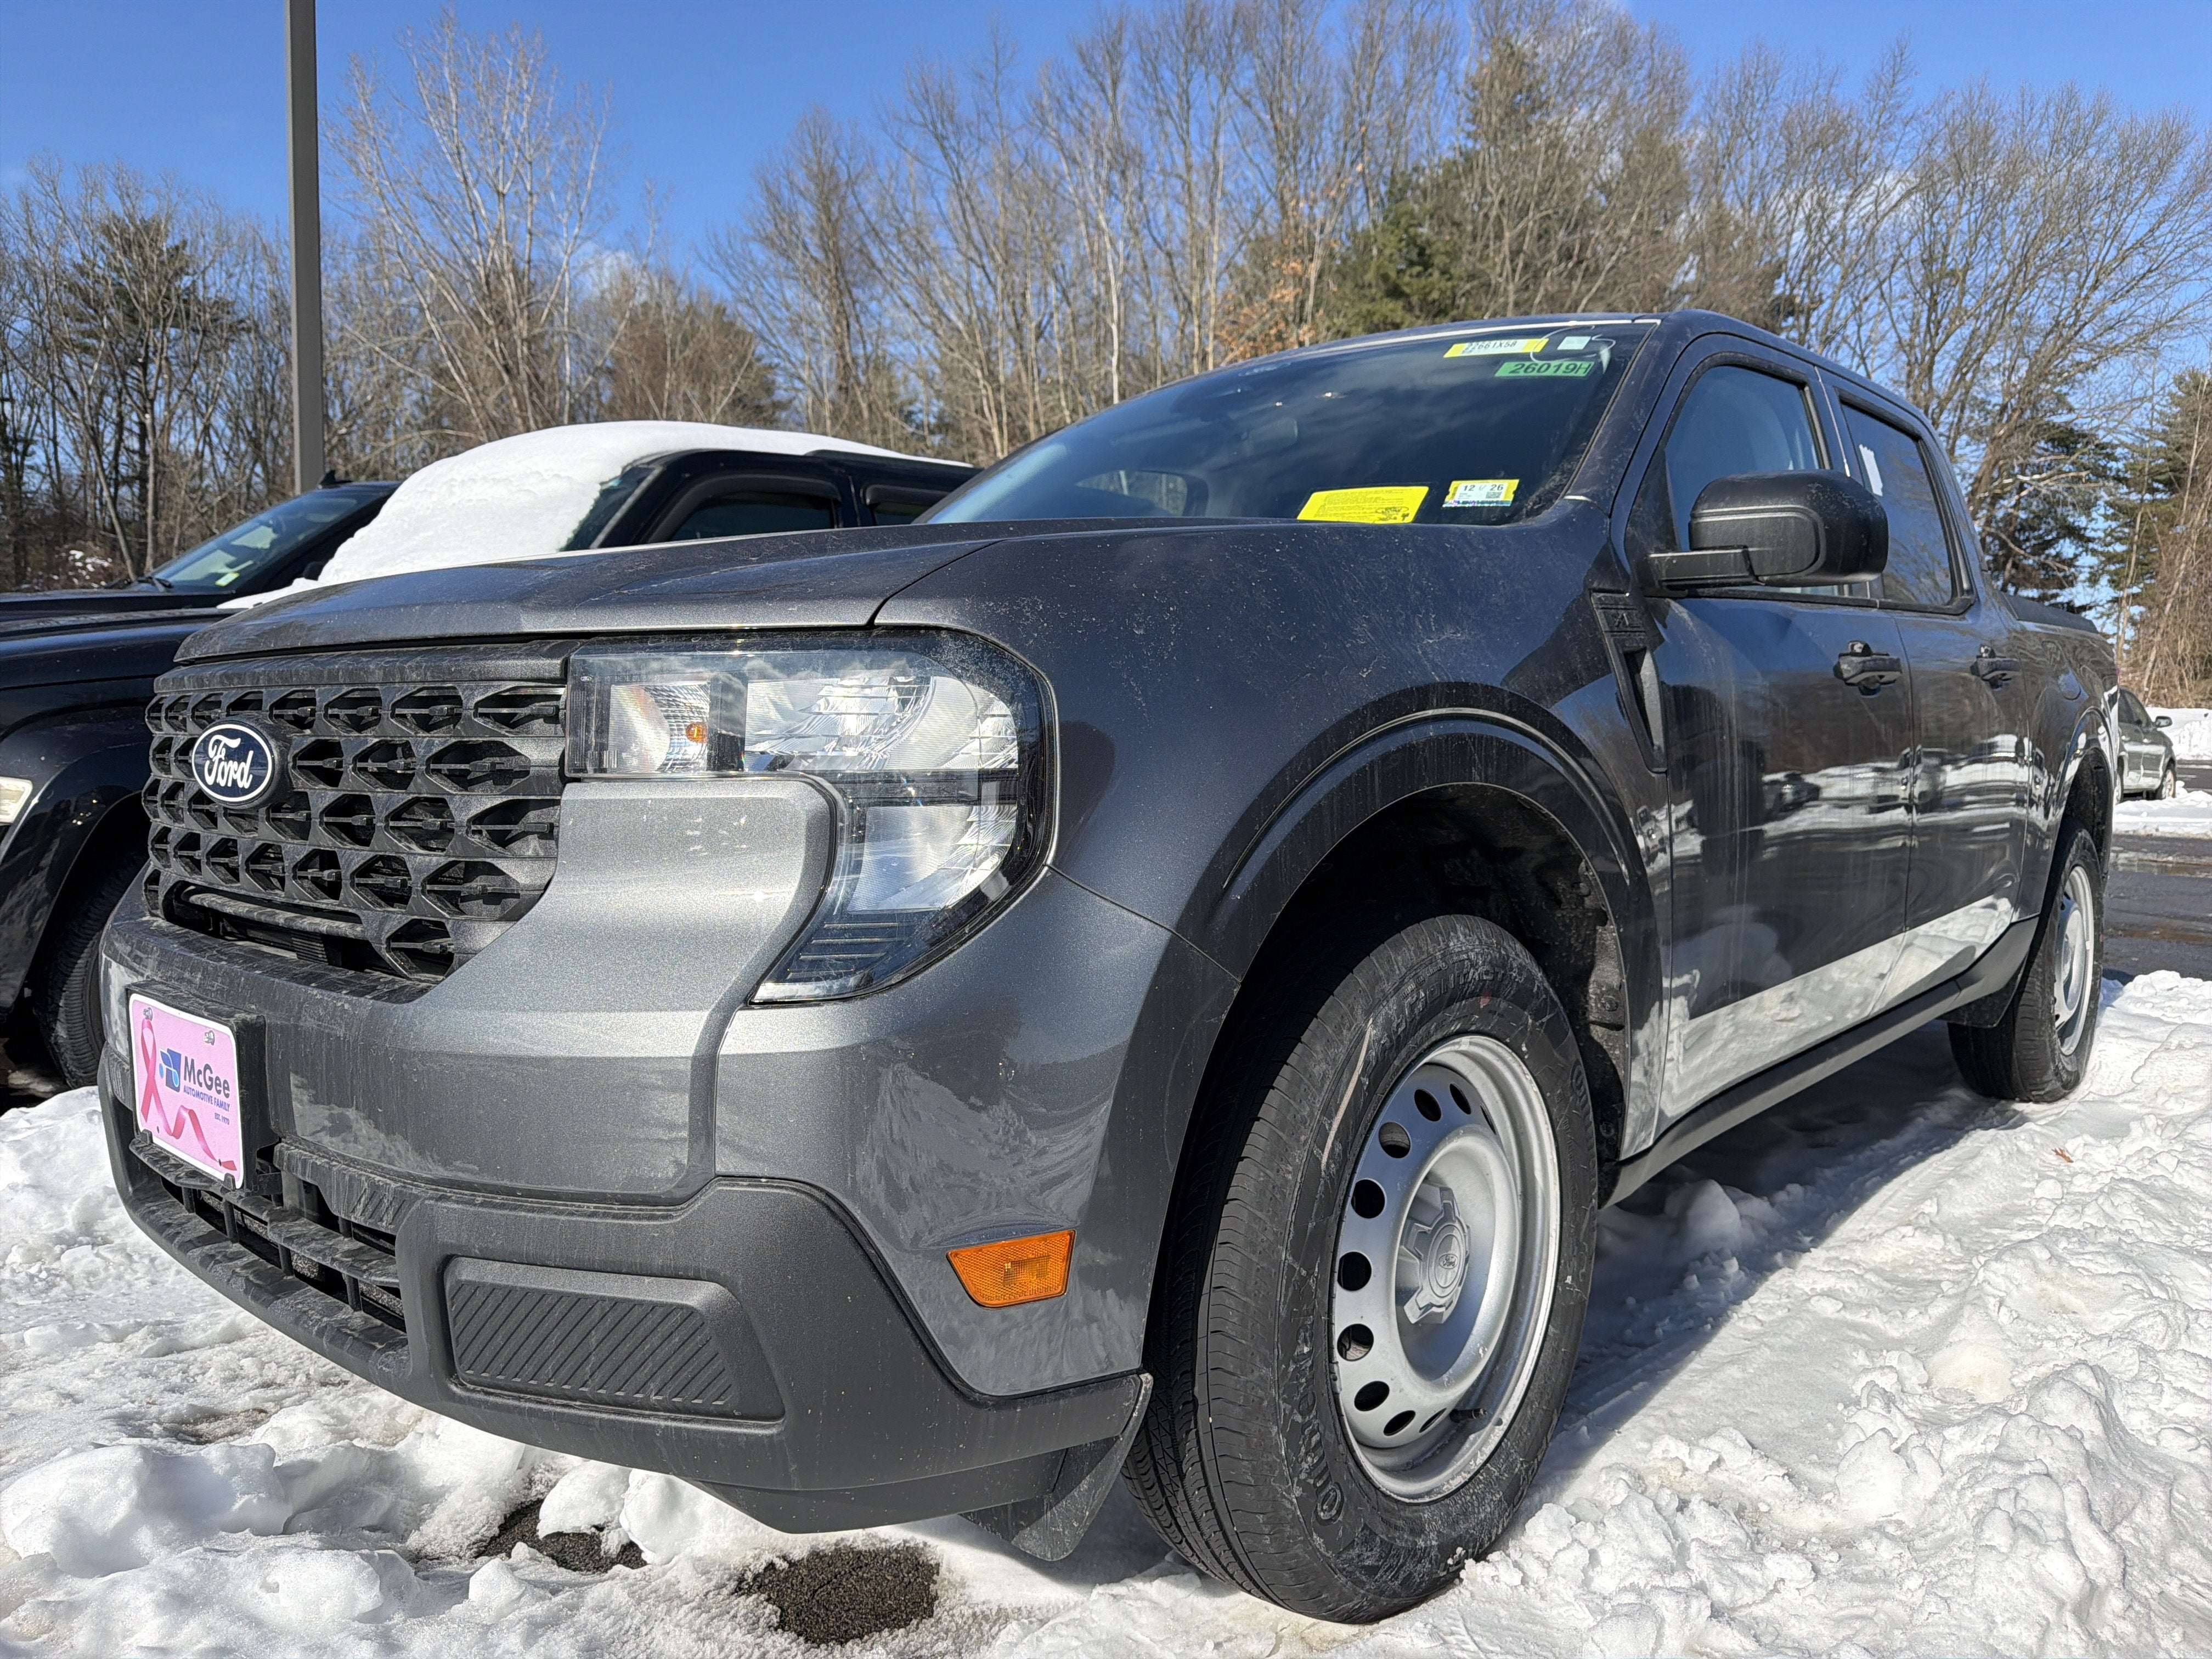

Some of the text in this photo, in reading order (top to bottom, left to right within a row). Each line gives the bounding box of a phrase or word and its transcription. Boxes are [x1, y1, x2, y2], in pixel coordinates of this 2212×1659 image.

[1508, 363, 1591, 374] 26019H
[204, 734, 254, 789] Ford
[183, 1056, 230, 1099] McGee
[183, 1085, 230, 1113] AUTOMOTIVE FAMILY
[221, 1115, 230, 1126] 1970
[1442, 1255, 1457, 1267] Ford
